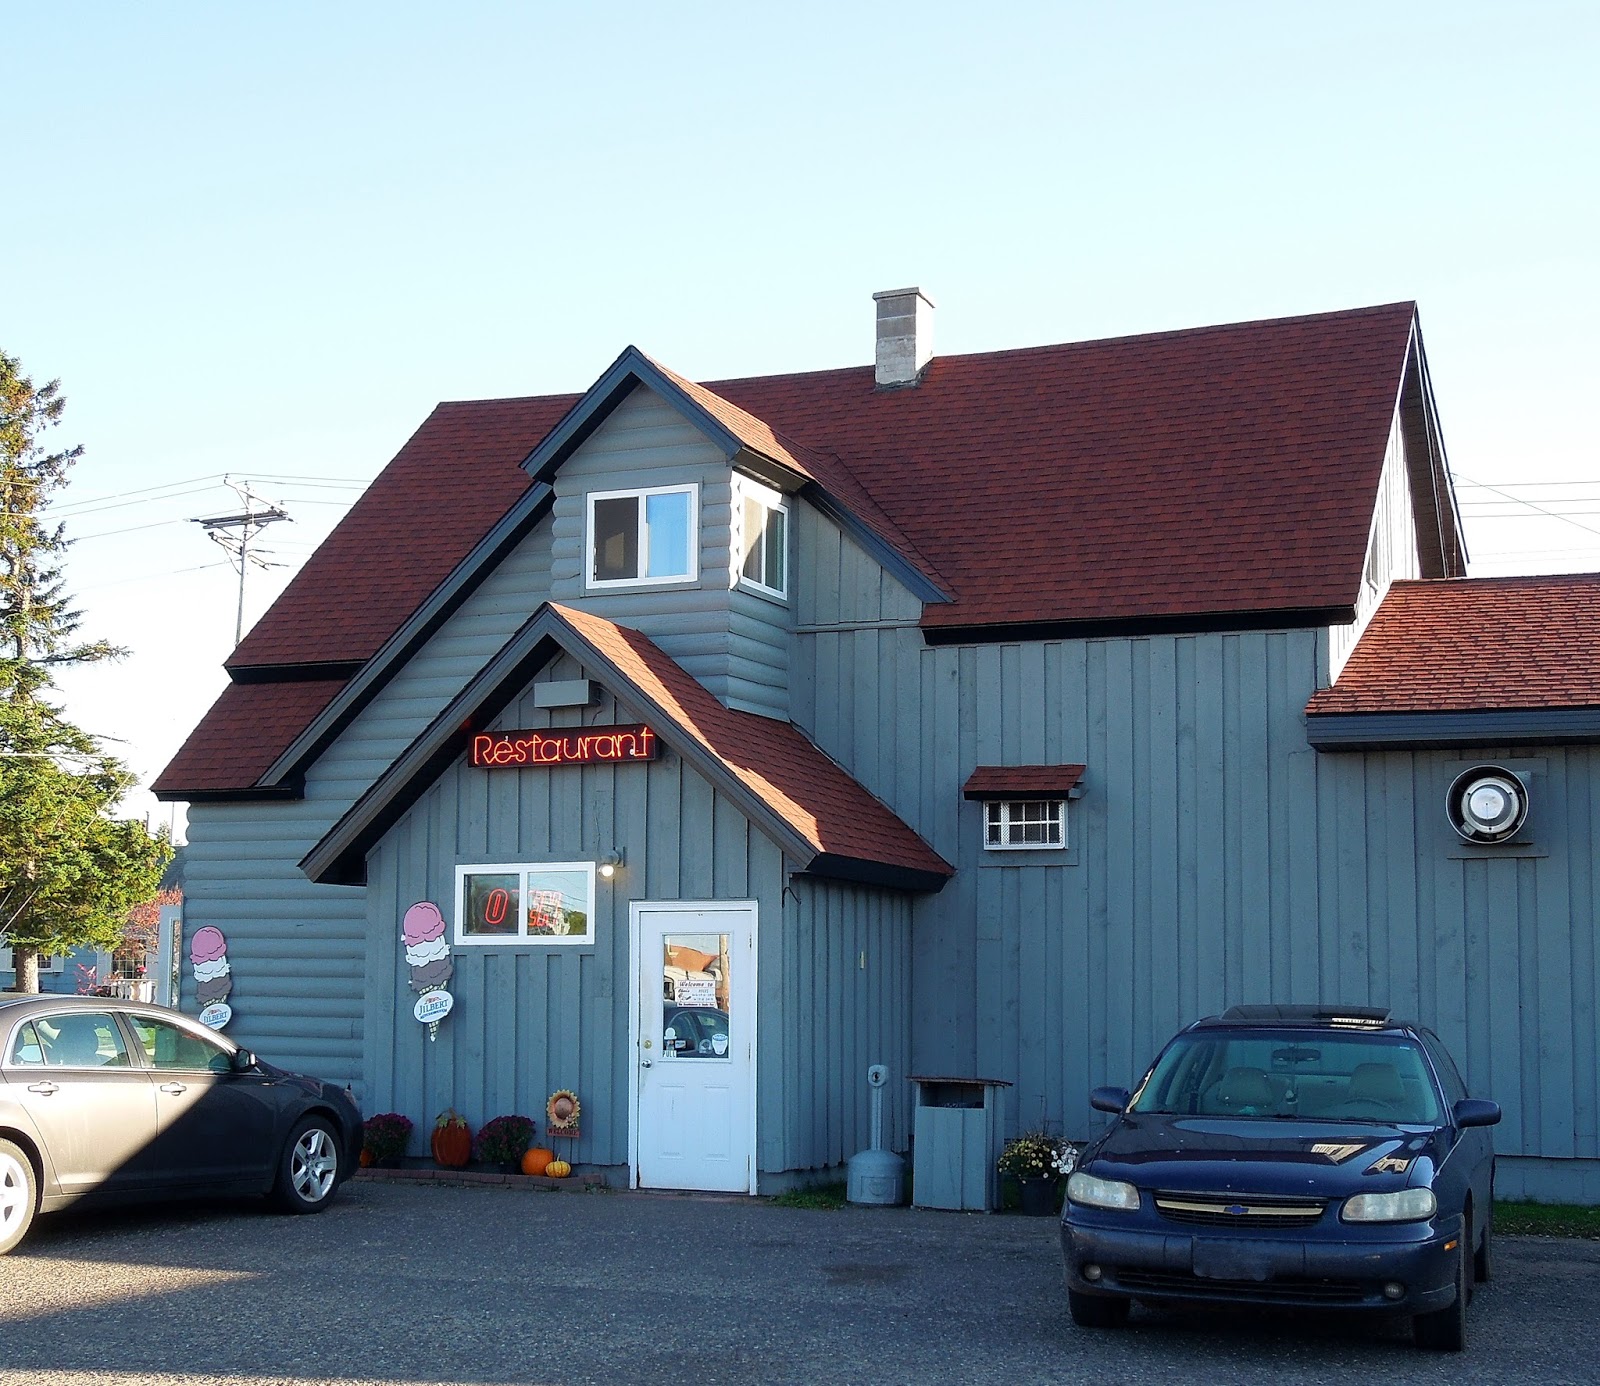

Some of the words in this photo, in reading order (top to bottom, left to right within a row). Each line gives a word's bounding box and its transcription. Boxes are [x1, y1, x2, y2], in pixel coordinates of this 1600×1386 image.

[474, 727, 654, 764] Restaurant
[418, 999, 449, 1016] JILBERT
[203, 1011, 228, 1023] JILBERT
[548, 1128, 578, 1136] WELCOME
